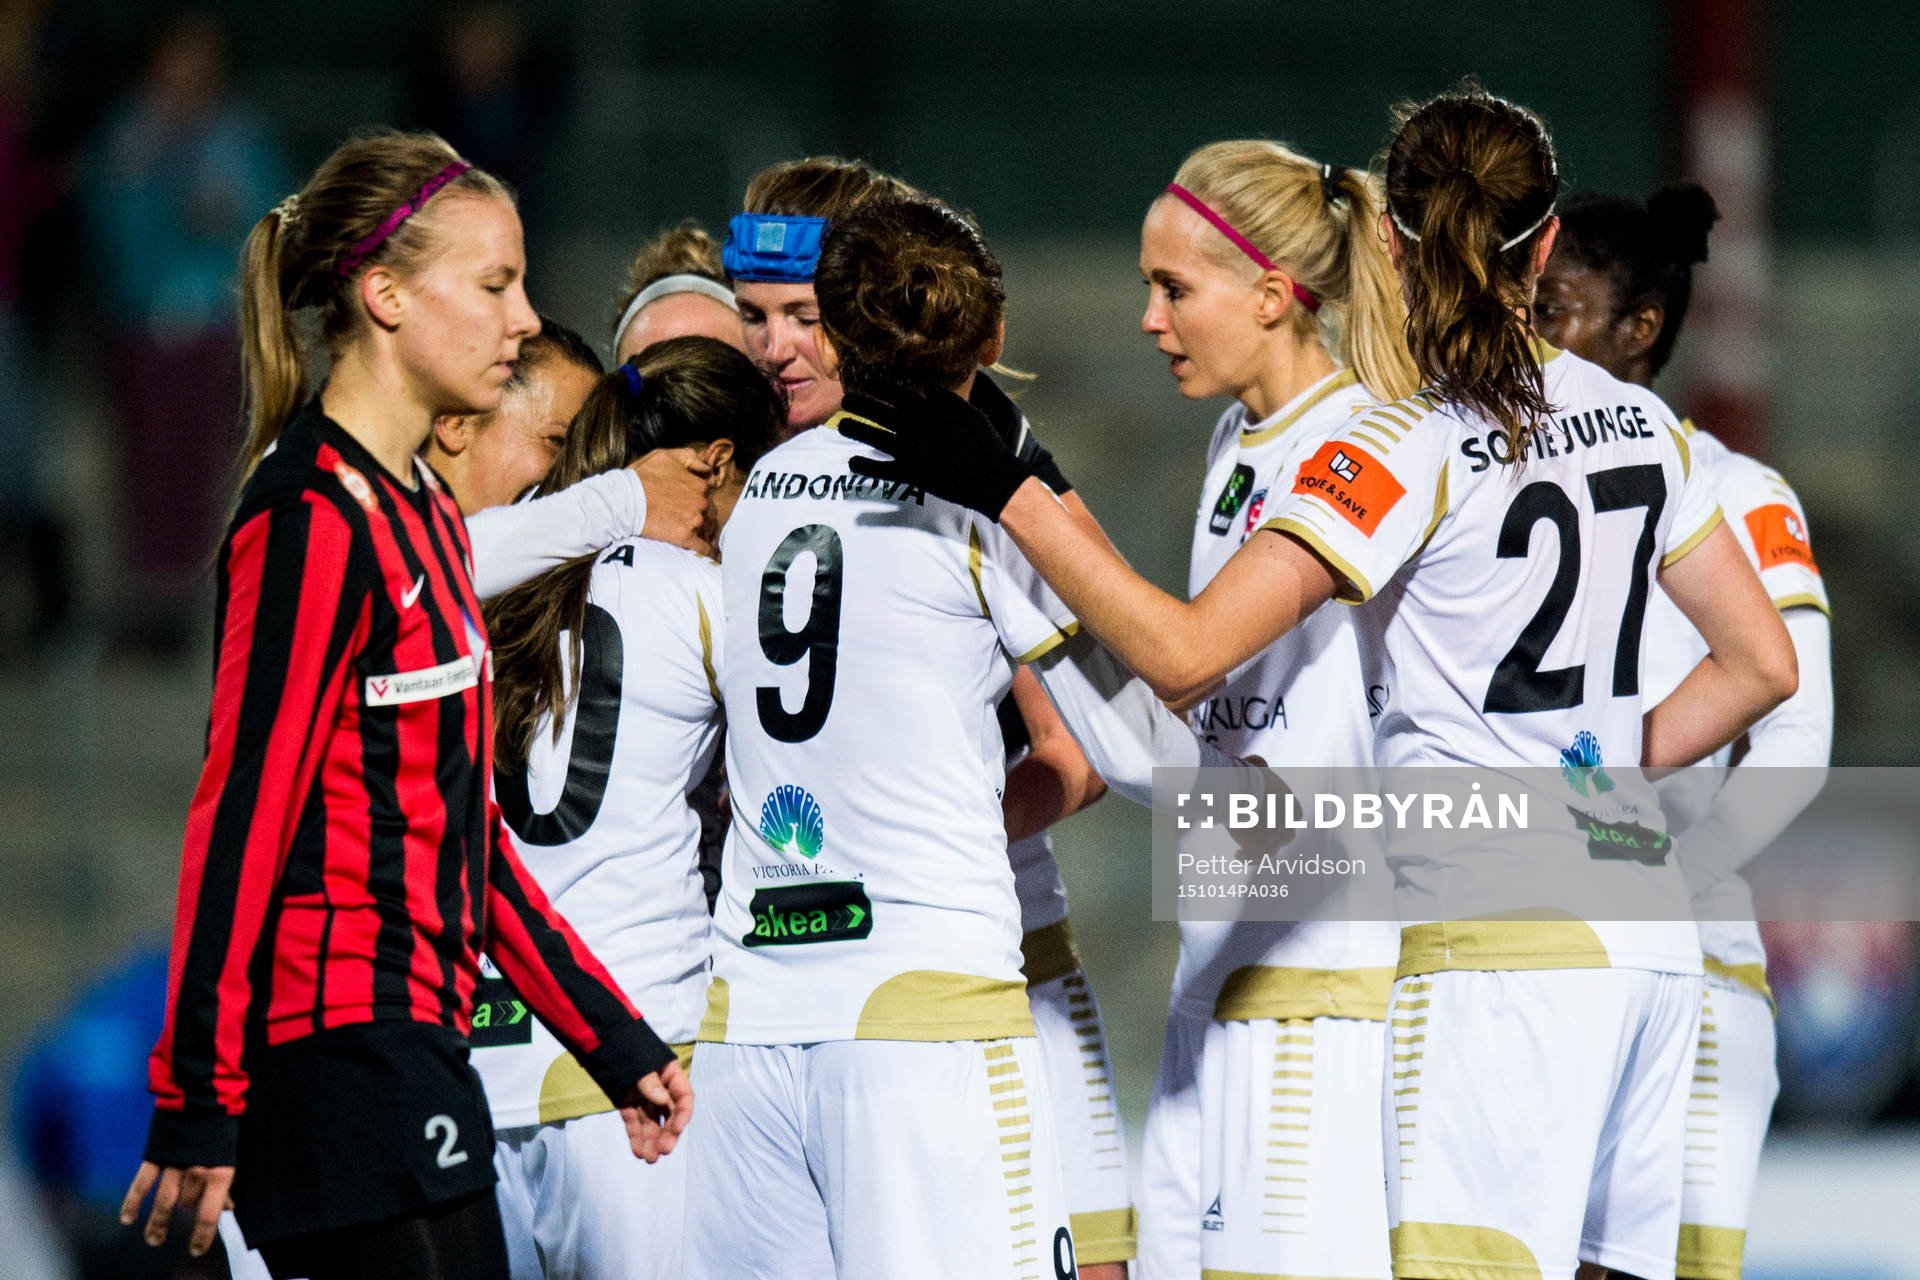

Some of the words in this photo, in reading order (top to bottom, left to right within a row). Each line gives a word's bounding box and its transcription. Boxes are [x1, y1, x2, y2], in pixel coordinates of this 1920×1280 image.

[1561, 405, 1654, 454] JUNGE
[744, 470, 925, 506] ANDONOVA
[1326, 484, 1337, 495] &
[1336, 491, 1367, 519] SAVE
[1483, 463, 1667, 714] 27
[756, 524, 843, 743] 9
[752, 864, 810, 880] VICTORIA
[755, 905, 827, 938] akea
[424, 1114, 469, 1170] 2
